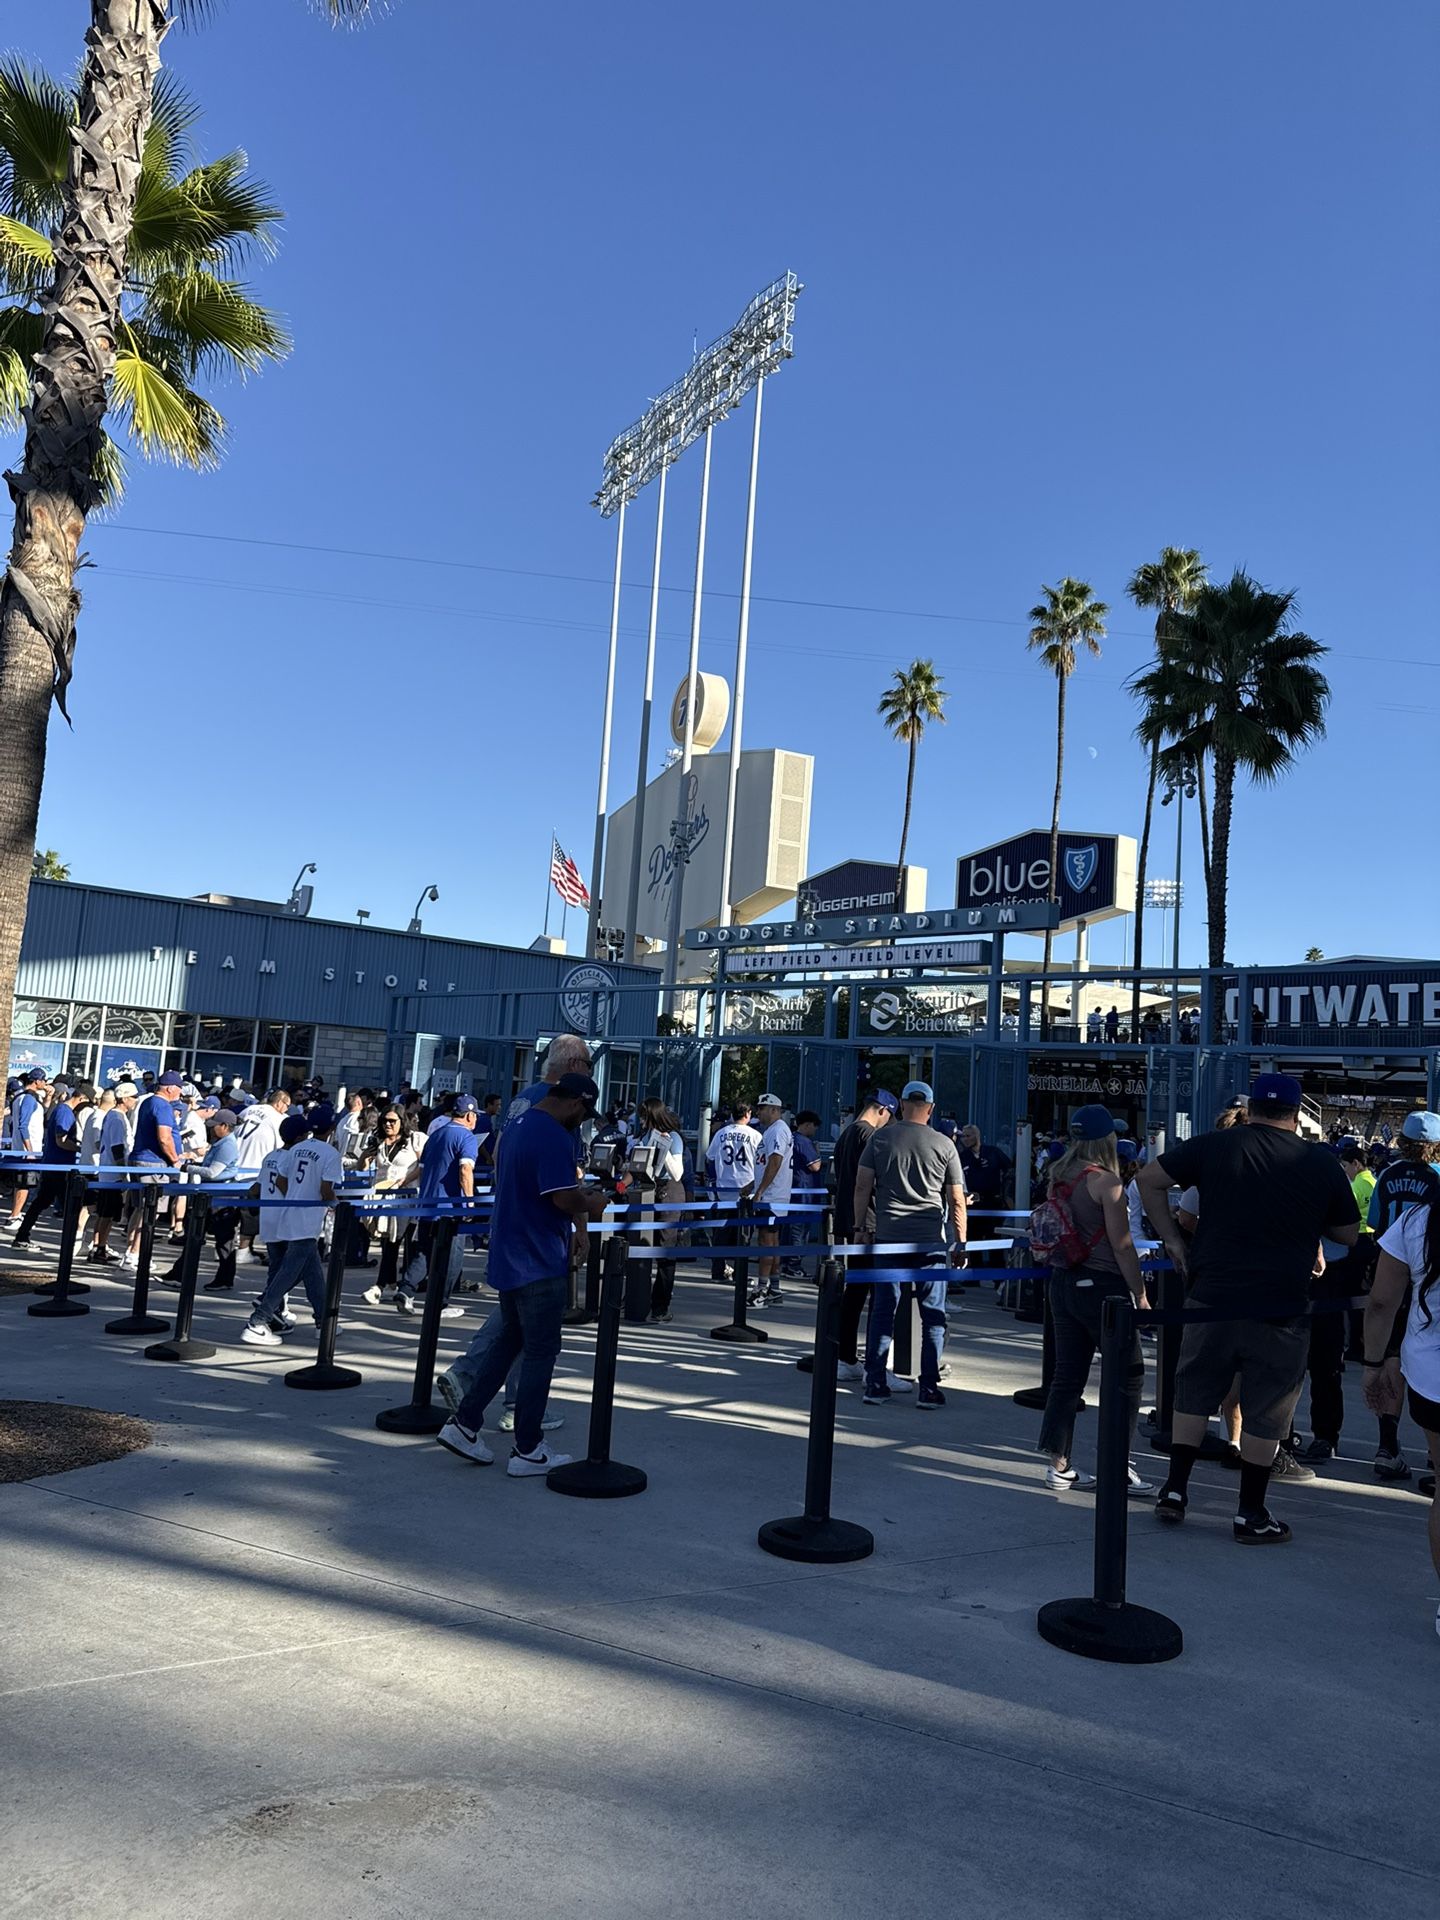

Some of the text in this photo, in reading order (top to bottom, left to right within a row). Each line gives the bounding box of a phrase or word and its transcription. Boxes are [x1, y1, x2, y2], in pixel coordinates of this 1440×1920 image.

[969, 855, 1050, 897] blue
[807, 892, 895, 913] UGGENHEIM
[698, 908, 1016, 943] DODGER STADIUM
[151, 945, 277, 974] TEAM
[744, 948, 954, 968] LEFT FIELD FIELD LEVEL
[571, 969, 605, 986] OFFICIAL
[760, 994, 815, 1014] Security
[904, 991, 971, 1014] Security
[760, 1014, 805, 1032] Benefit
[904, 1012, 961, 1032] Benefit
[1027, 1075, 1103, 1092] STRELLA
[720, 1132, 751, 1145] CABRERA
[722, 1144, 748, 1166] 34
[296, 1160, 309, 1185] 5
[268, 1171, 277, 1195] 5
[1386, 1178, 1429, 1196] OHTANI
